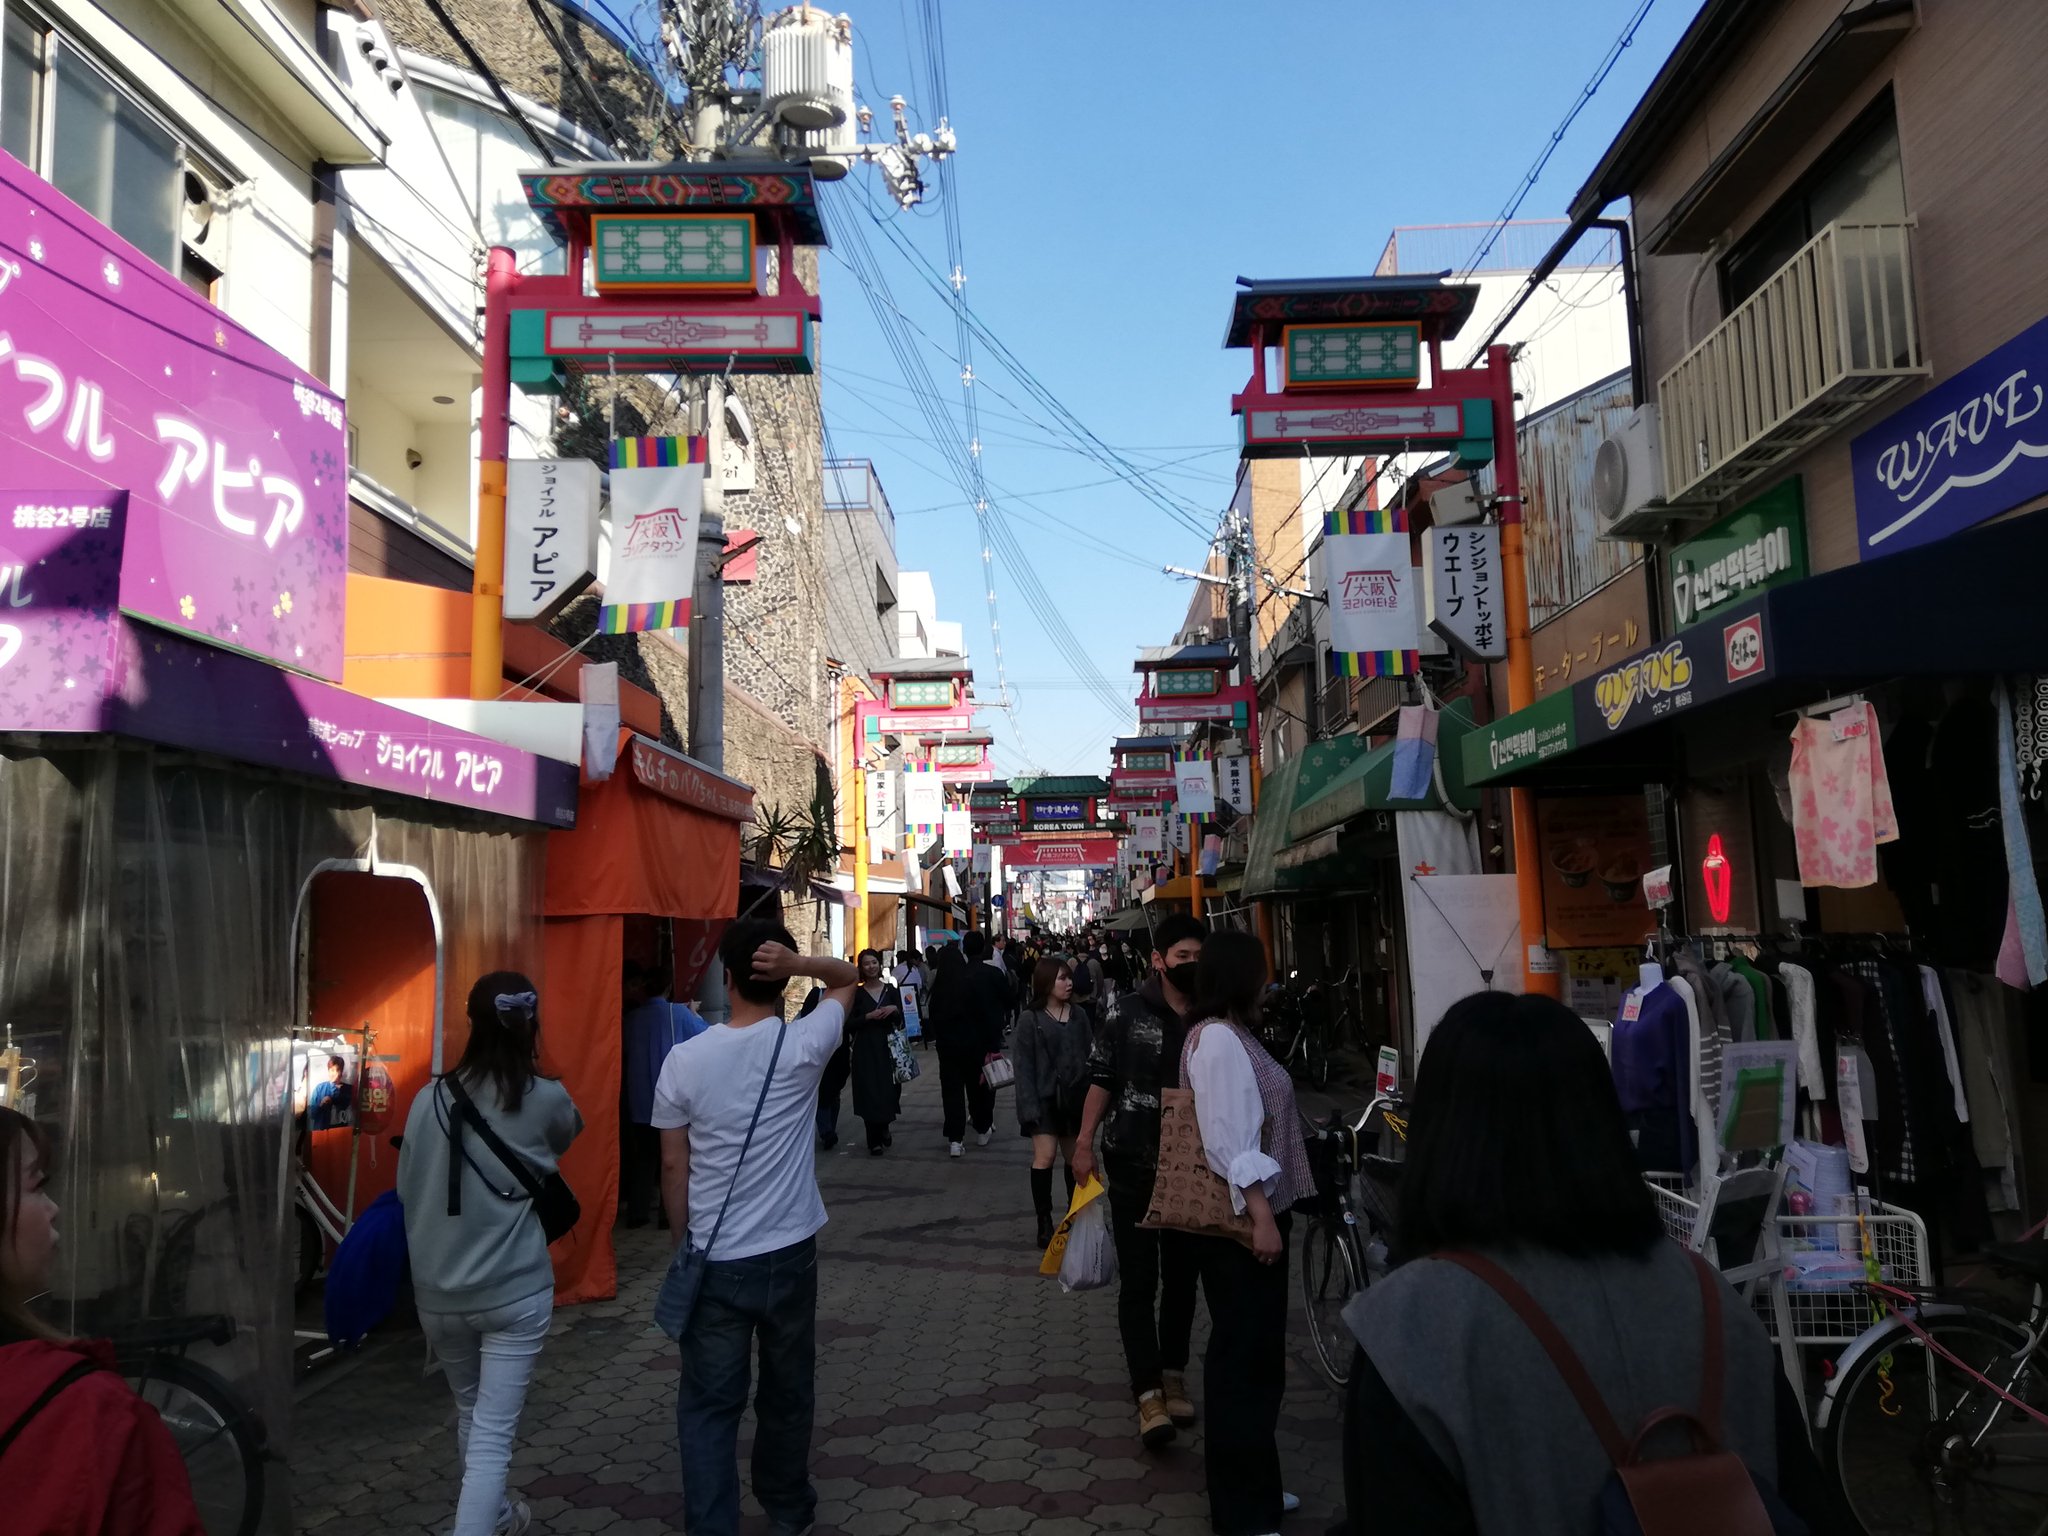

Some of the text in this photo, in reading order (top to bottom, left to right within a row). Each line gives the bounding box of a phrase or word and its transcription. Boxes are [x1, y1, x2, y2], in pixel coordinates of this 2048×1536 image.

[0, 337, 302, 549] フル アピア
[1876, 369, 2043, 503] WAVE
[13, 505, 112, 529] 桃谷2号店
[530, 464, 558, 601] ジョイフル アピア
[639, 522, 669, 539] 大阪
[621, 540, 686, 558] コリアタウン
[1694, 526, 1791, 611] 신전떡볶이
[1354, 582, 1386, 597] 大阪
[1443, 532, 1465, 617] ウエーブ
[1469, 532, 1493, 650] シンジョントッポギ
[1342, 595, 1398, 610] 코리아타운
[1731, 632, 1758, 667] たばこ
[1595, 640, 1692, 730] WAVE
[376, 734, 445, 780] ジョイフル
[455, 751, 502, 794] アピア
[1499, 728, 1536, 765] 신전떡볶이
[1033, 823, 1060, 831] KOREA
